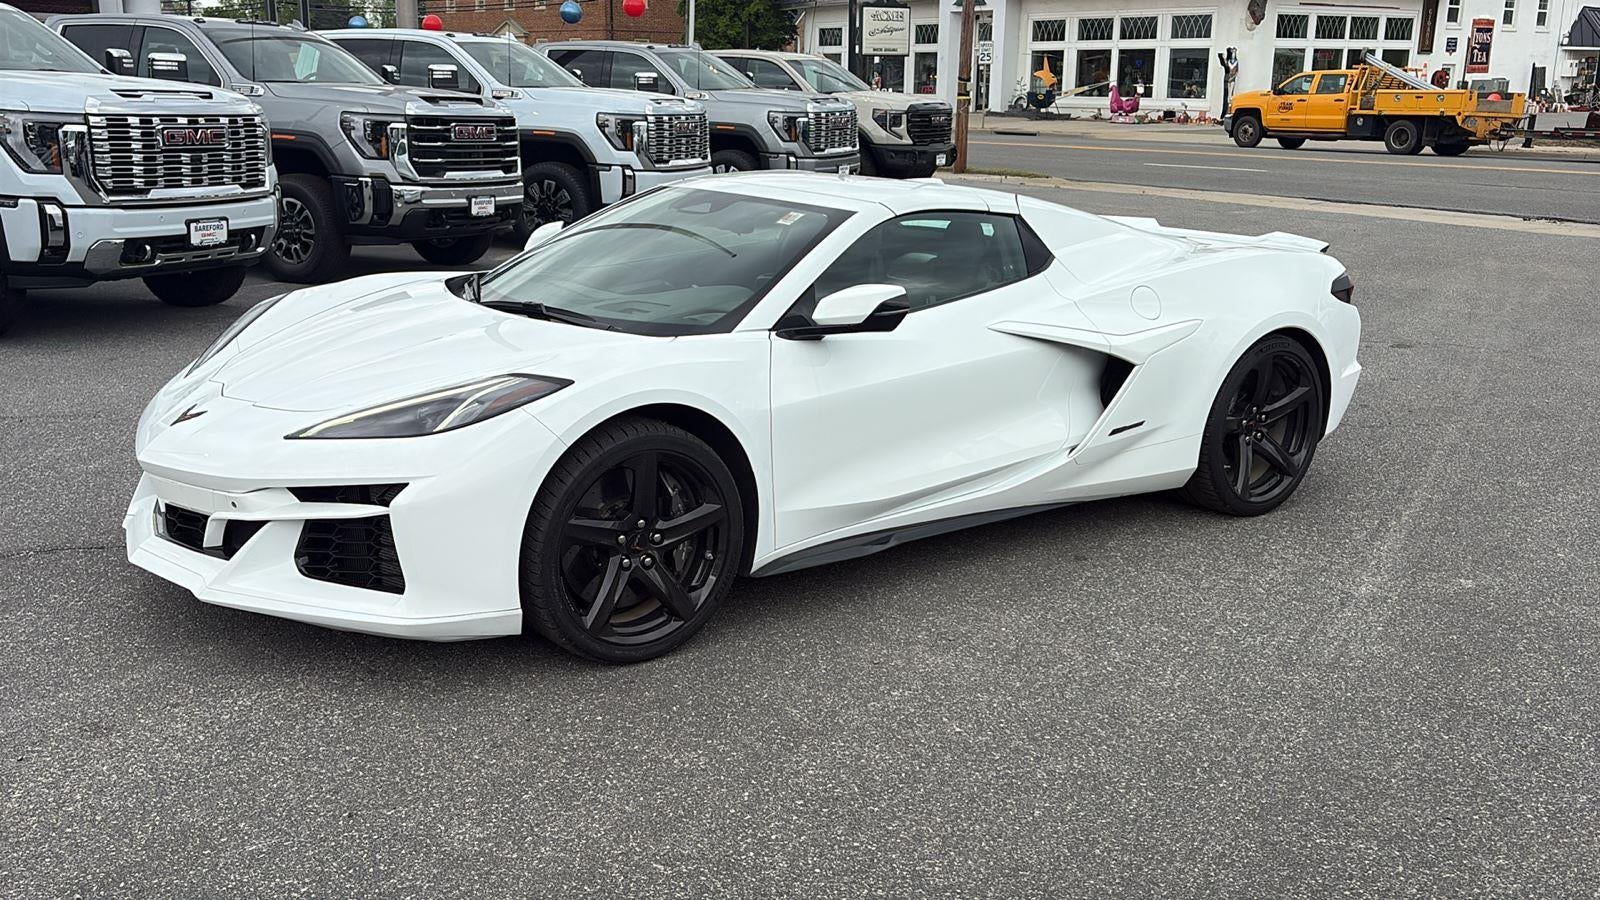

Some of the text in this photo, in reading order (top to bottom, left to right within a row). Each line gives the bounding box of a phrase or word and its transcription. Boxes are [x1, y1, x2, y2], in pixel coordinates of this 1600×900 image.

[870, 10, 905, 22] ACME
[980, 52, 992, 61] 25
[1472, 49, 1487, 63] TEA
[163, 129, 226, 145] GMC
[455, 126, 495, 139] GMC
[194, 223, 225, 232] BAREFORD
